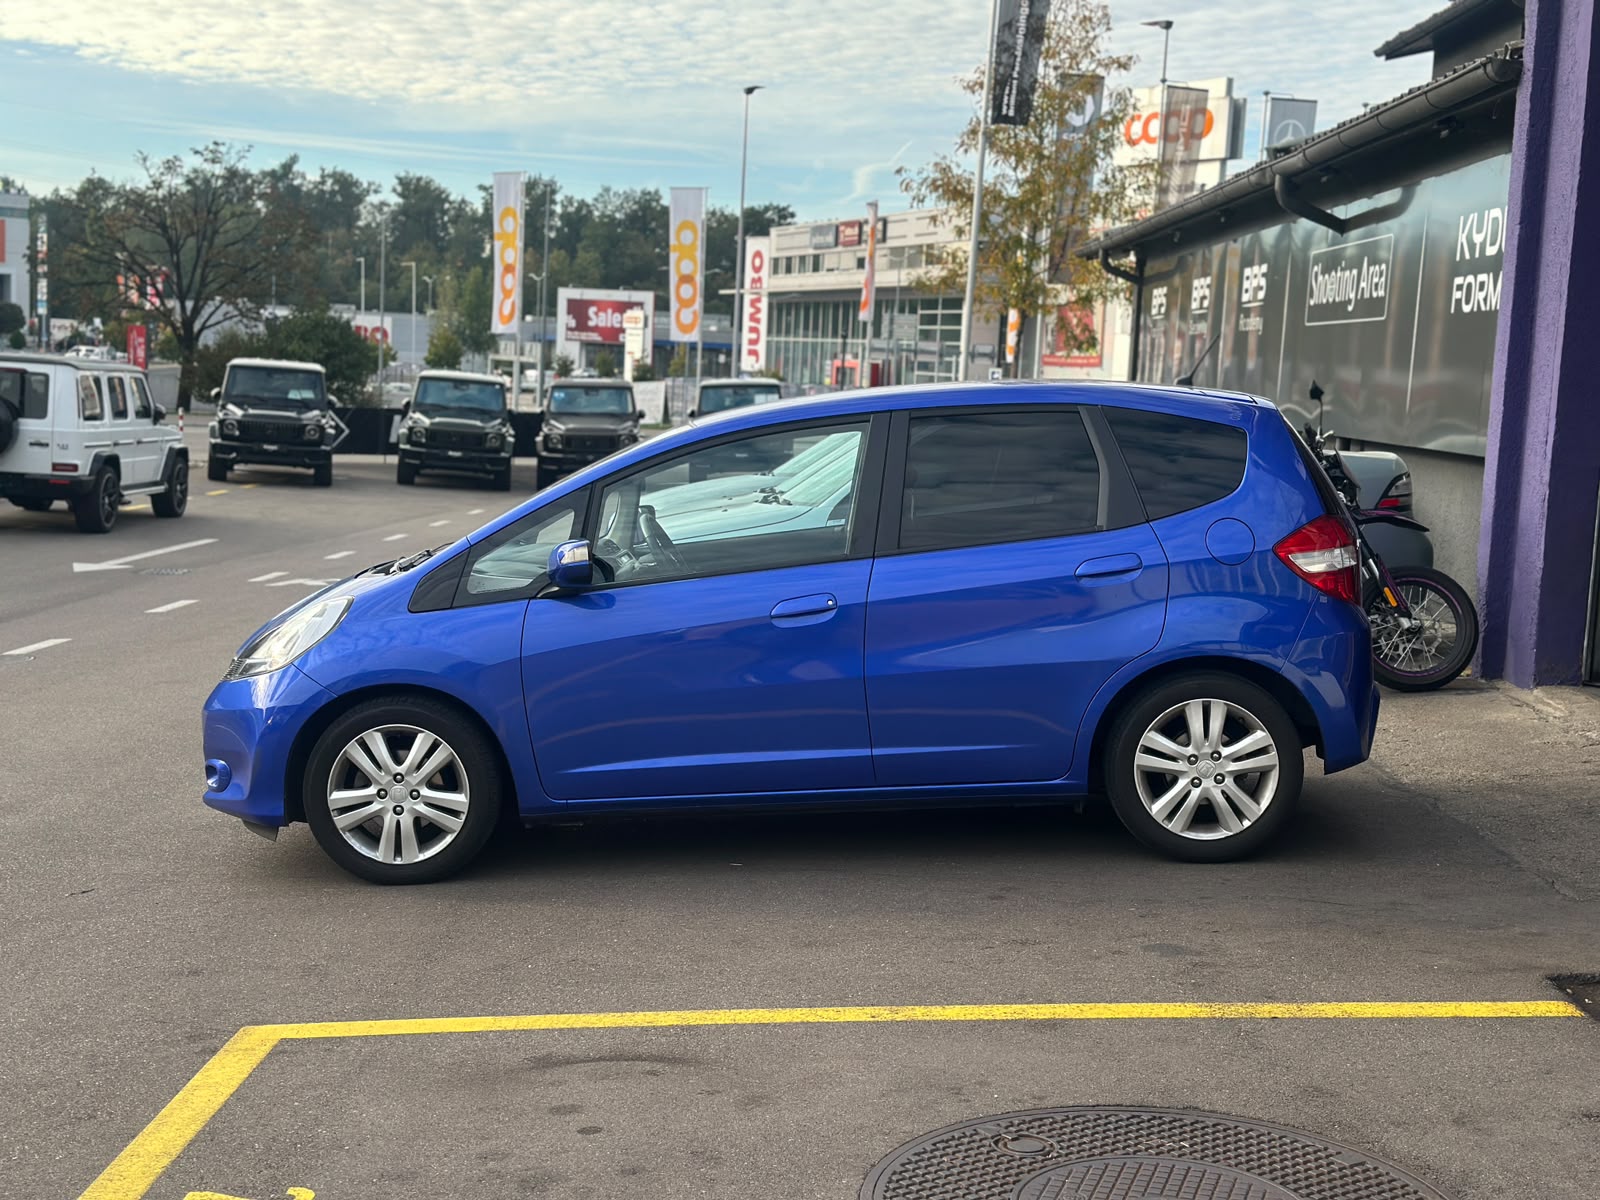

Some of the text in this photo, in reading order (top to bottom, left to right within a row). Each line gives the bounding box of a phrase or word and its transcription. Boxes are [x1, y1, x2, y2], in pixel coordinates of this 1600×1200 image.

[1124, 107, 1215, 152] coop
[494, 206, 519, 326] coop
[669, 220, 699, 335] coop
[747, 250, 764, 364] JUMBO
[1309, 255, 1387, 313] Shooting Area
[588, 306, 622, 328] Sale
